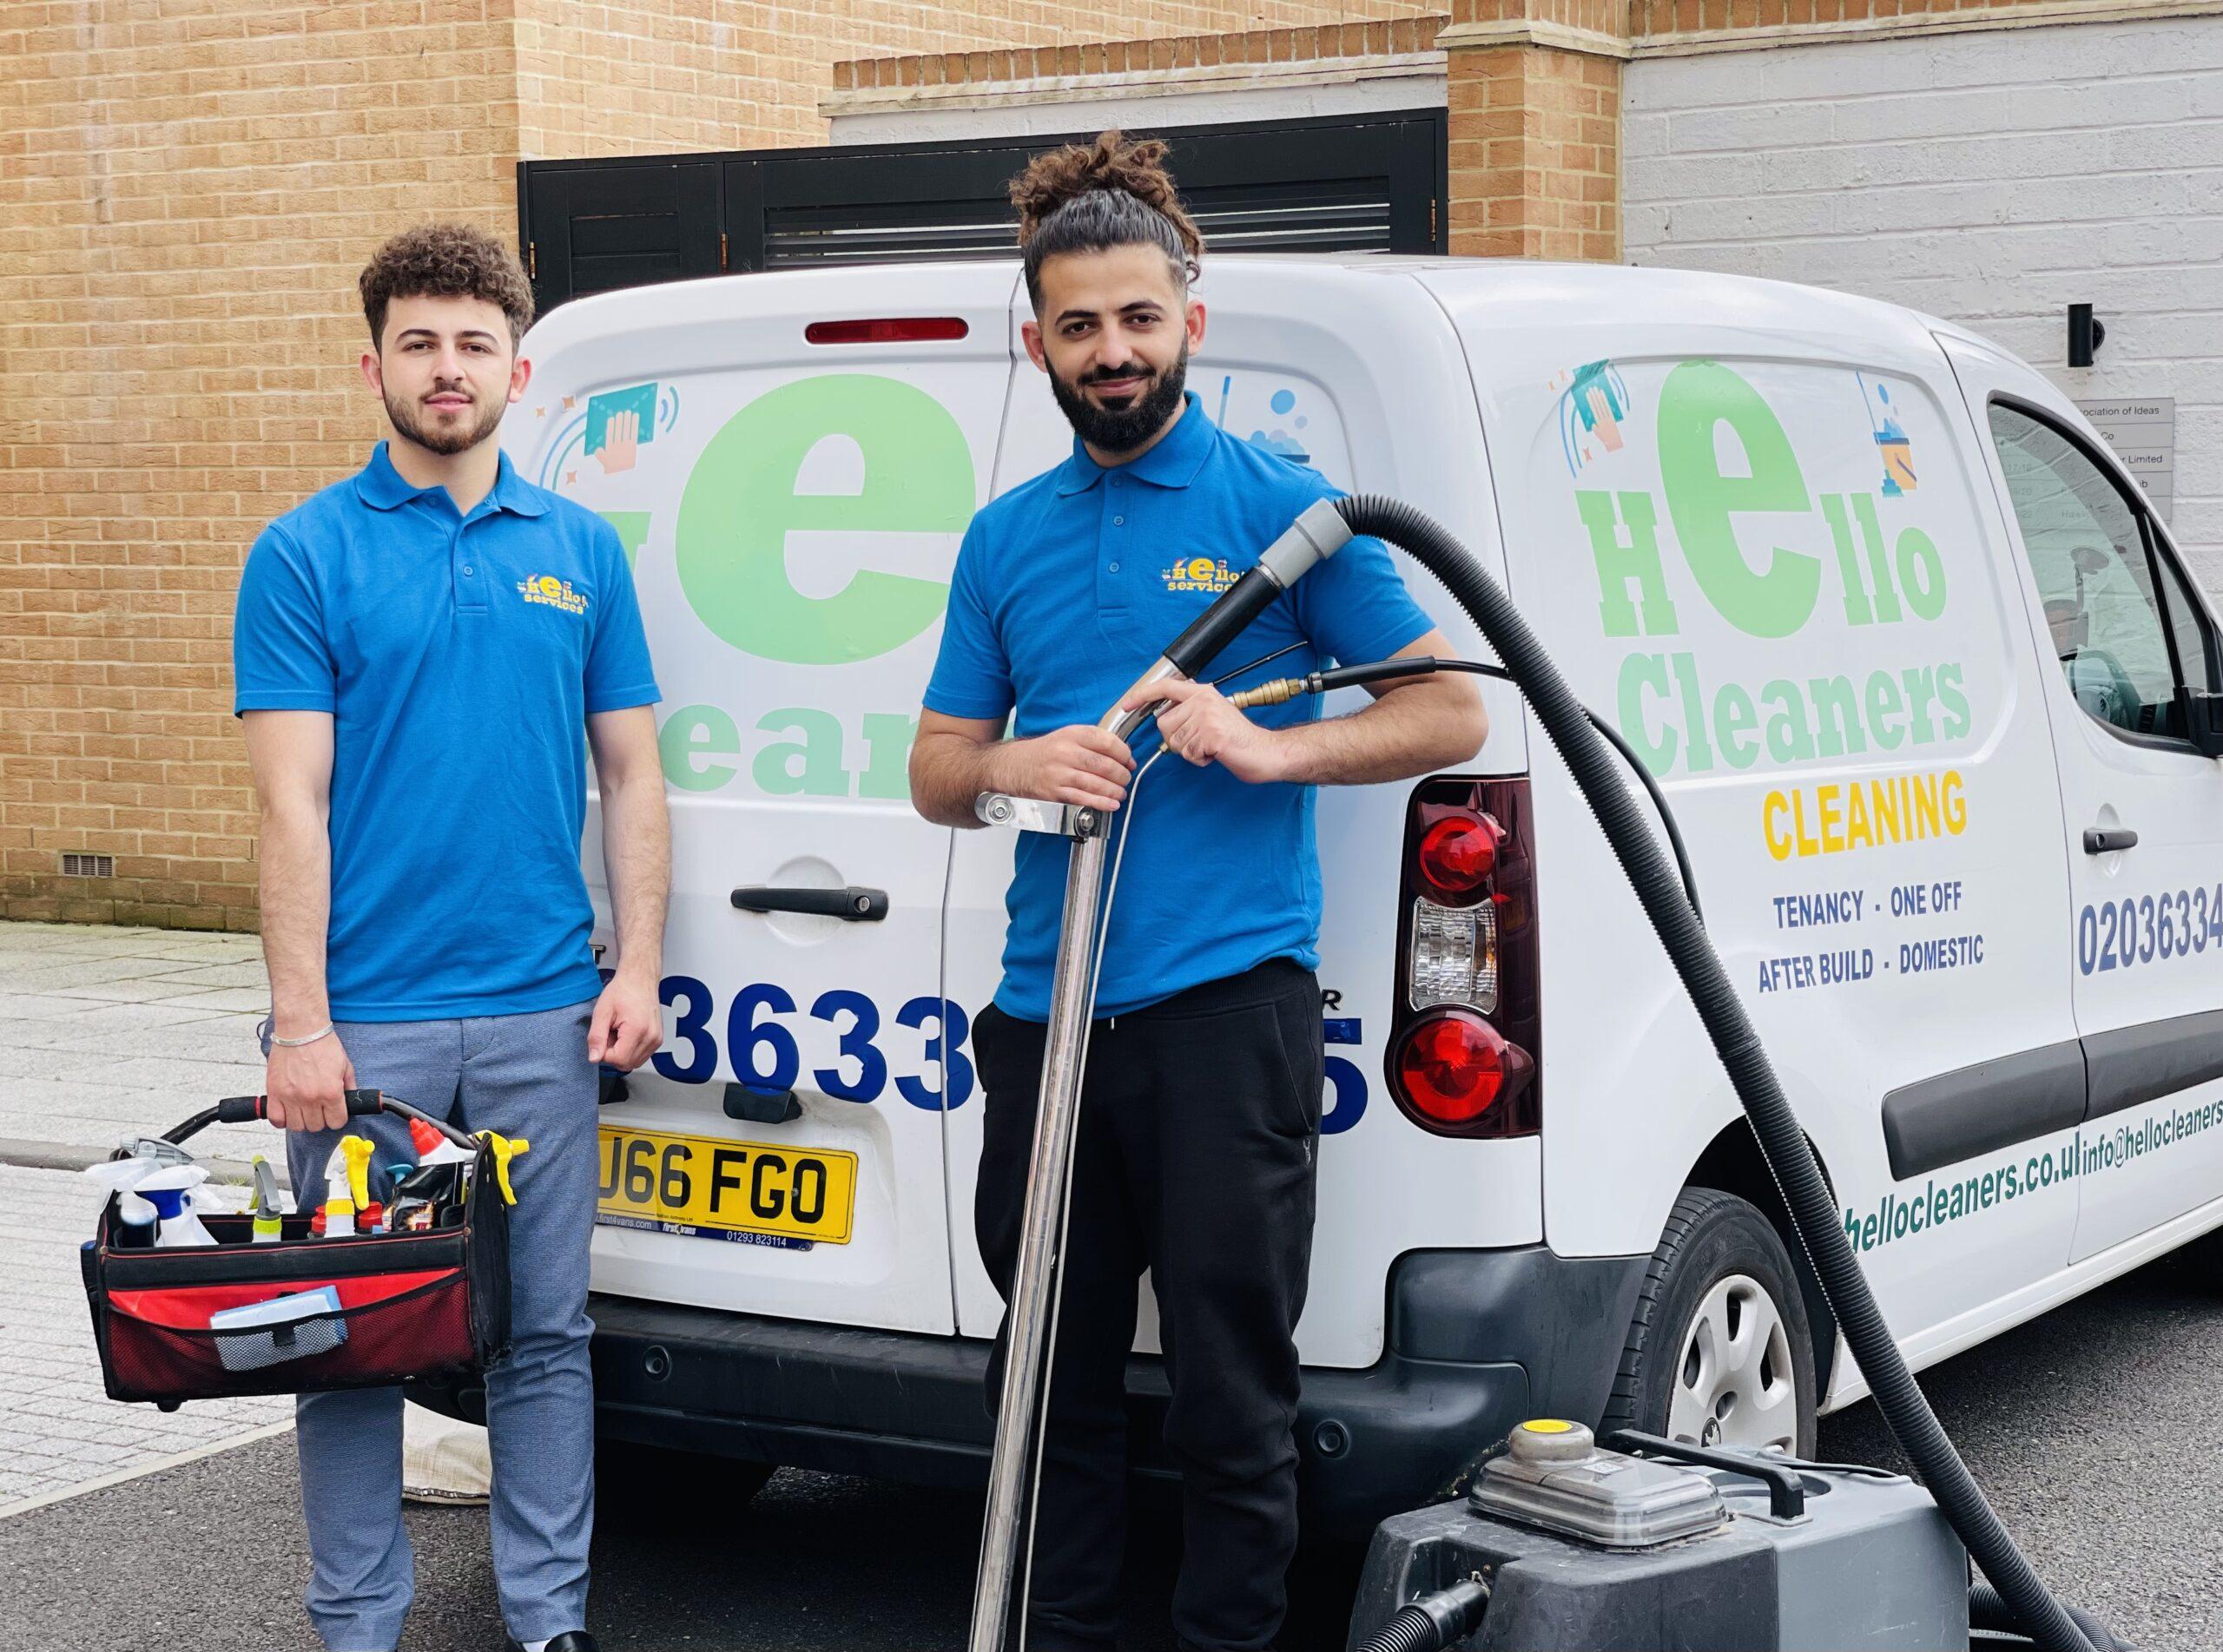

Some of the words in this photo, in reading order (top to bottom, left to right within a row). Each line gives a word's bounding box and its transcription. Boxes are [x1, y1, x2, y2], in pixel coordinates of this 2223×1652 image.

[2081, 407, 2120, 417] ociation
[2122, 406, 2132, 415] of
[2134, 406, 2160, 415] Ideas
[2128, 455, 2163, 464] Limited
[597, 373, 976, 665] e
[1573, 359, 1947, 639] Hello
[524, 594, 584, 615] services
[1168, 580, 1232, 592] service
[1617, 651, 1972, 779] Cleaners
[1763, 770, 1968, 861] CLEANING
[1773, 890, 1863, 929] TENANCY
[1890, 885, 1927, 917] ONE
[1931, 881, 1962, 913] OFF
[2079, 883, 2223, 976] 02036334
[1758, 955, 1817, 993] AFTER
[1819, 948, 1873, 985] BUILD
[1900, 934, 1984, 975] DOMESTIC
[598, 968, 974, 1111] 3633
[2082, 1100, 2223, 1175] info@hellocleaners
[596, 1214, 652, 1229] .first4vans.com
[726, 1230, 754, 1242] 01293
[755, 1234, 787, 1247] 823114
